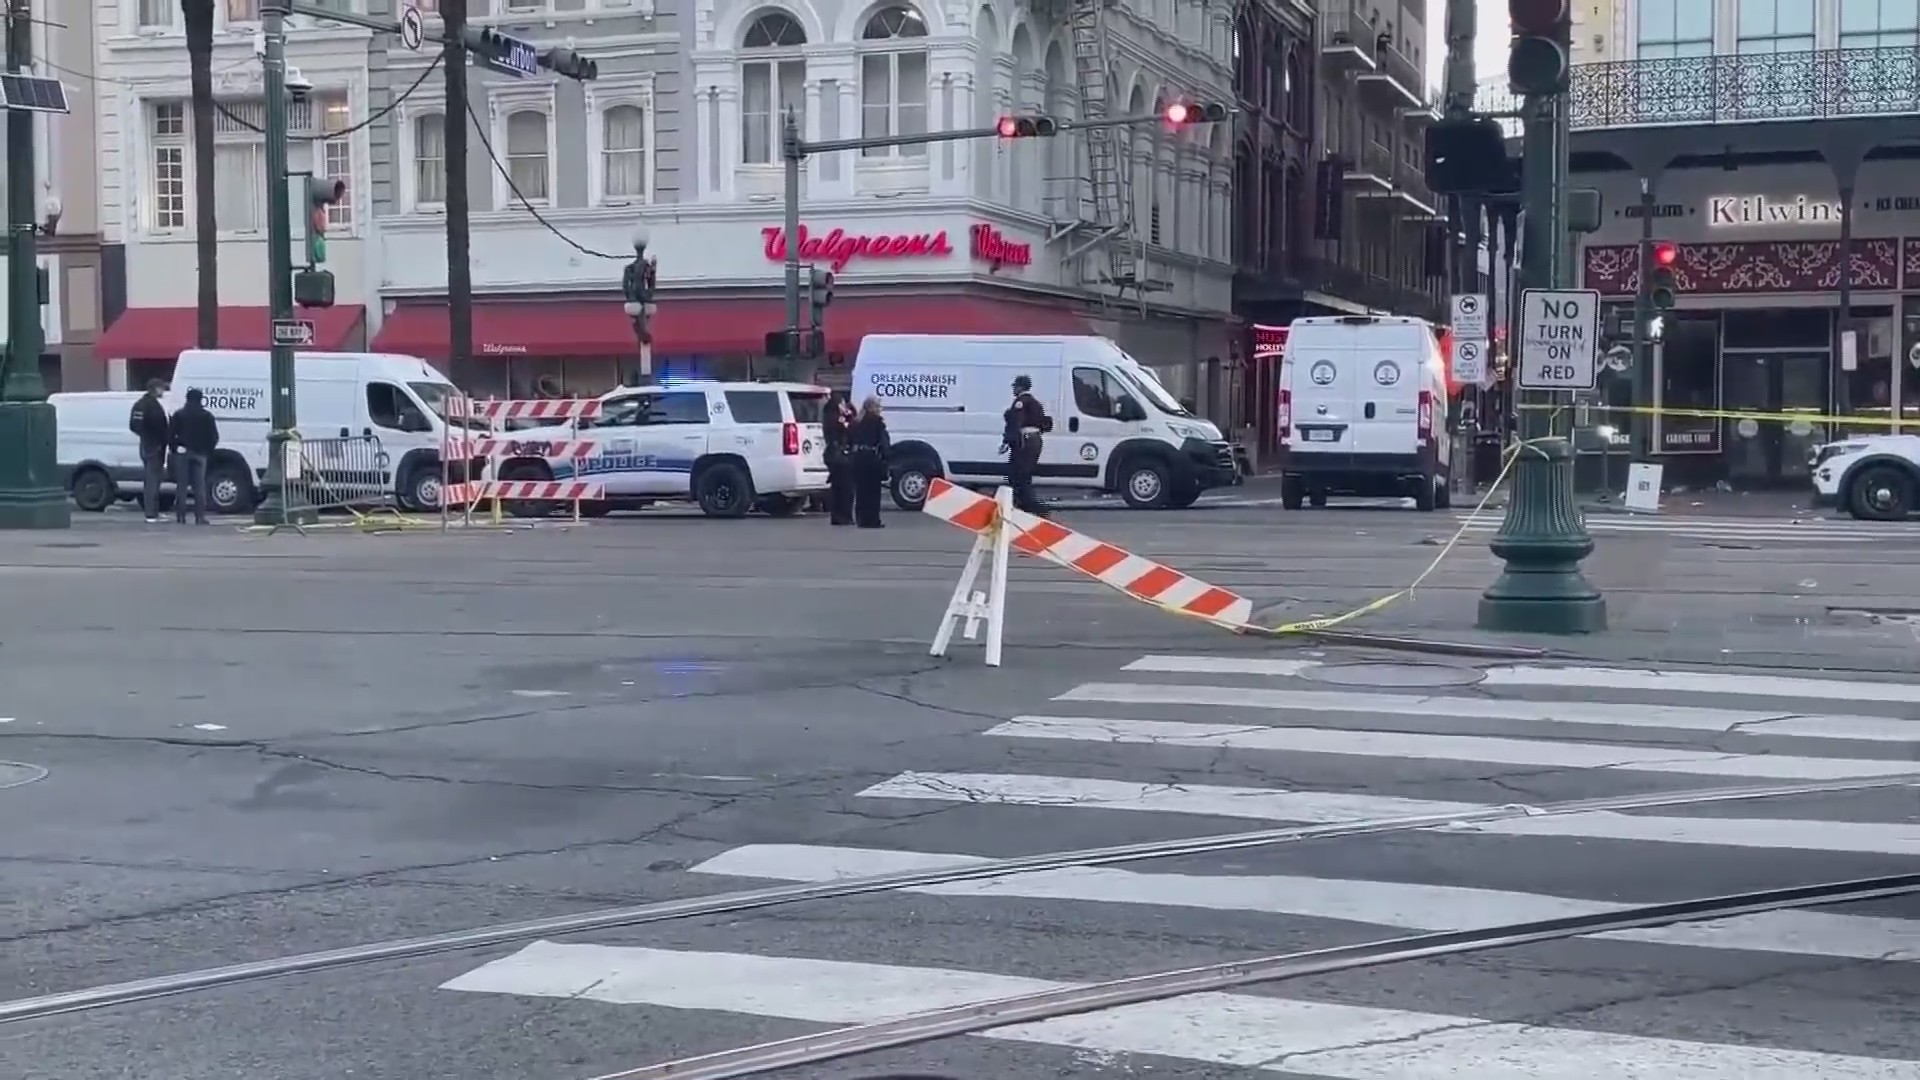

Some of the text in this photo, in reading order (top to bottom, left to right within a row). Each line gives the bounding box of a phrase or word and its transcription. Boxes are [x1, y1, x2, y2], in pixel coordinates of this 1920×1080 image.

[1711, 196, 1843, 223] Kilwins
[761, 224, 953, 273] Walgreens
[1542, 299, 1579, 319] NO
[1538, 324, 1583, 340] TURN
[1548, 345, 1571, 359] ON
[871, 373, 957, 385] ORLEANS PARISH
[1541, 365, 1576, 379] RED
[230, 387, 264, 398] PARISH
[876, 383, 948, 398] CORONER
[200, 396, 256, 409] ORONER
[588, 455, 657, 469] POLICE
